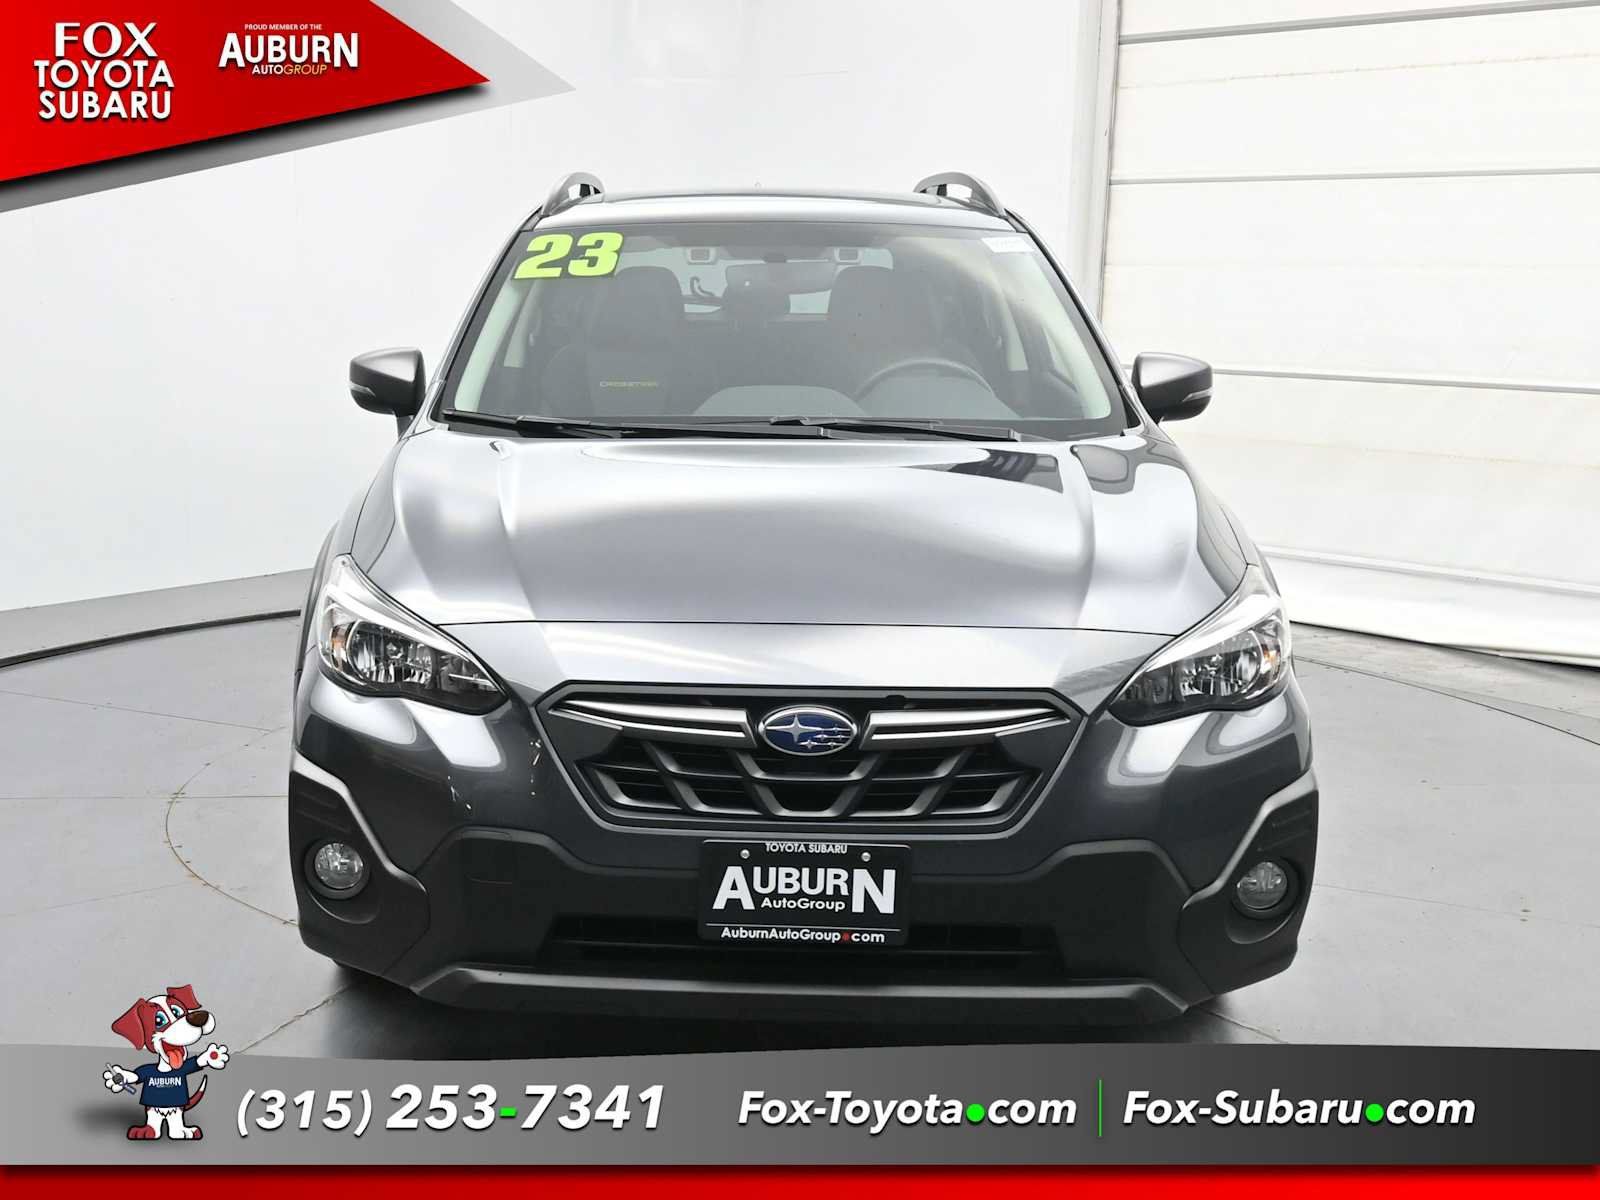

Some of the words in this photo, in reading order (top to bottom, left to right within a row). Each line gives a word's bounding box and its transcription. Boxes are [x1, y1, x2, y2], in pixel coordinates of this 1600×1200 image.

[514, 231, 624, 279] 23
[765, 842, 806, 853] TOYOTA
[808, 843, 848, 854] SUBARU
[712, 866, 896, 914] AUBURN
[760, 897, 846, 912] AutoGroup
